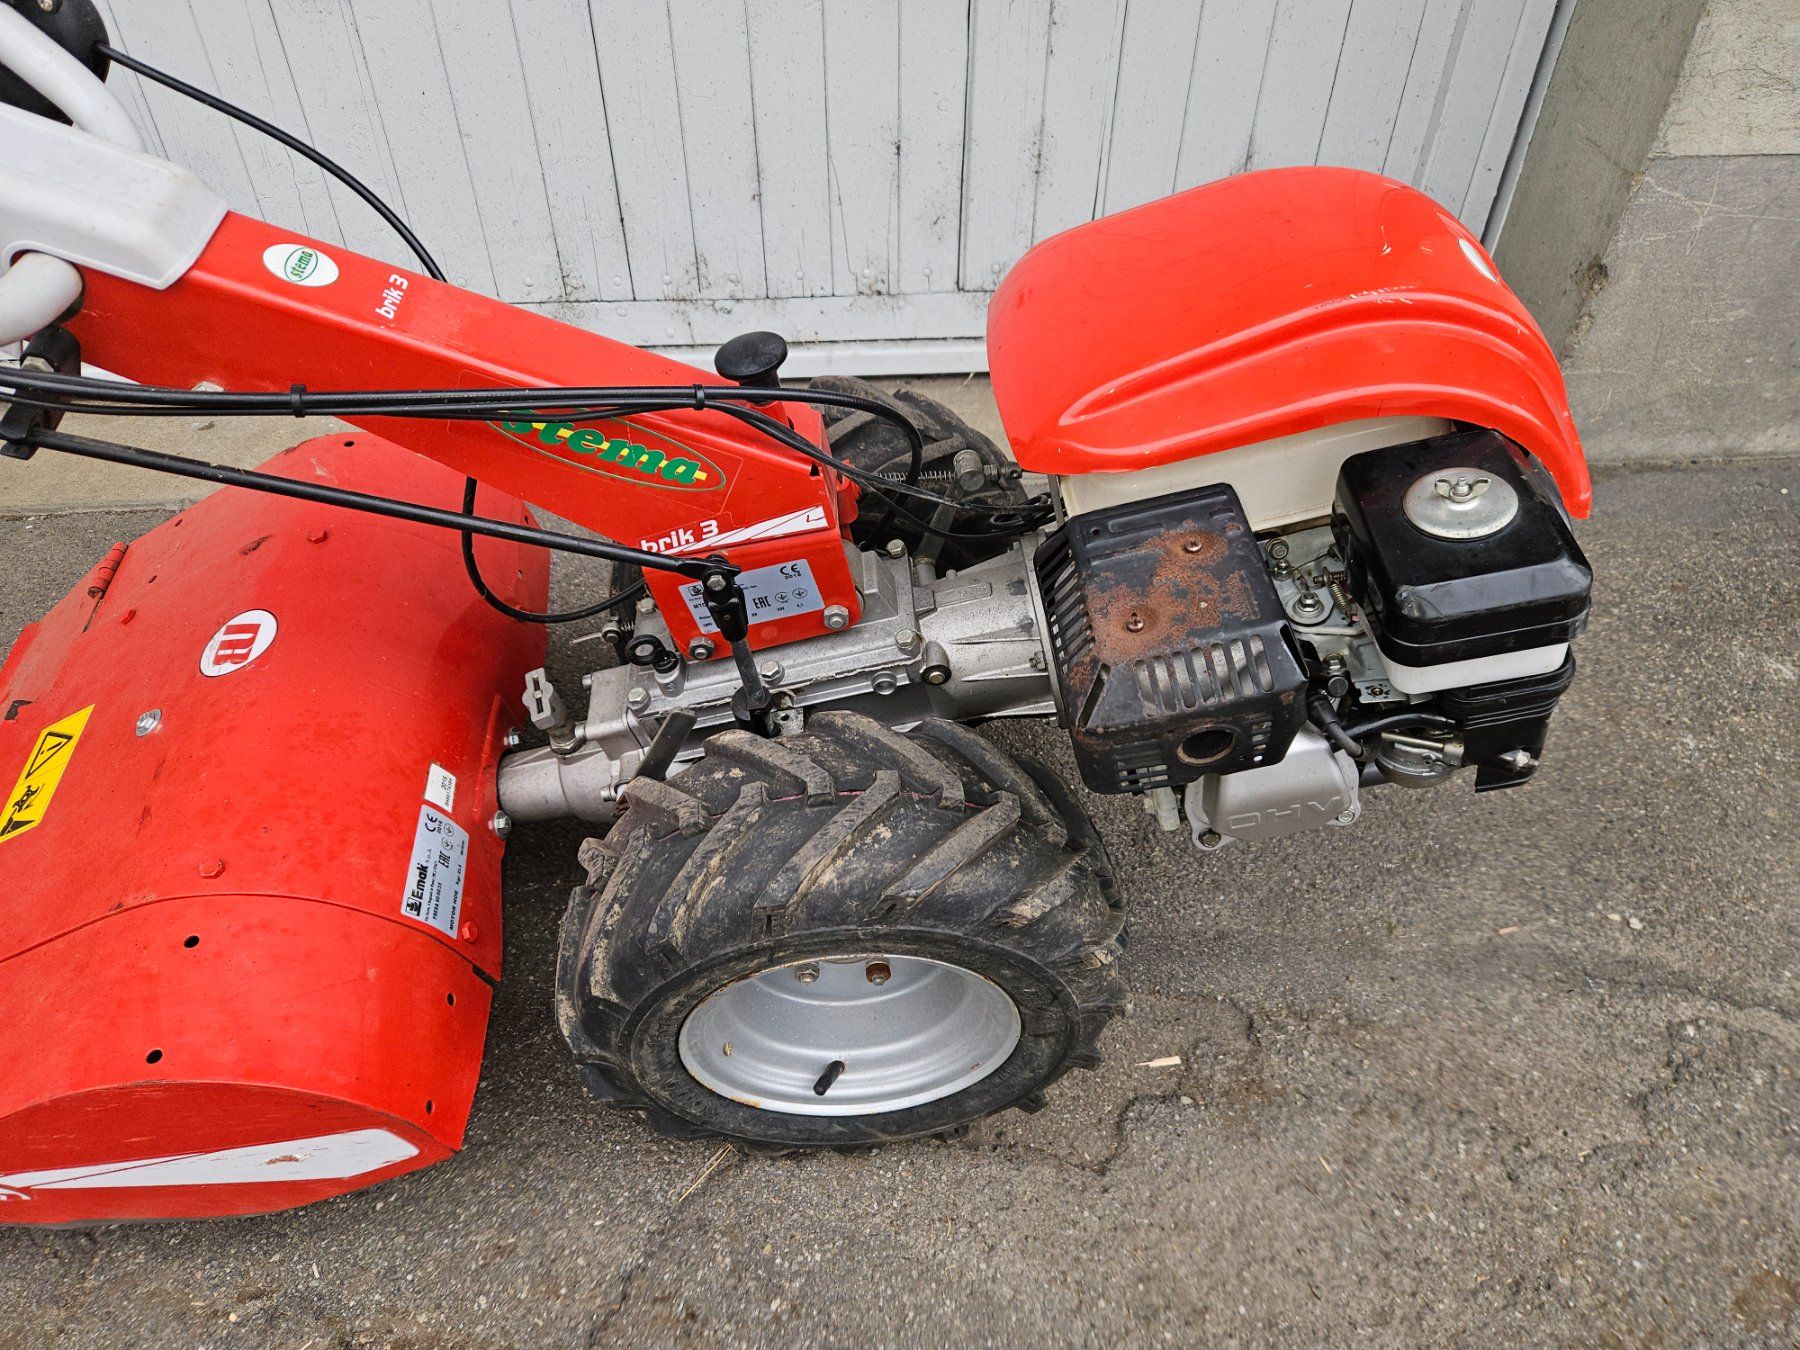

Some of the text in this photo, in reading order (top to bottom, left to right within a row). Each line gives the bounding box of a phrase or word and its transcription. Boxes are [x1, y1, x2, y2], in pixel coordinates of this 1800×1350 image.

[290, 250, 314, 279] stema
[375, 273, 409, 320] brik 3
[640, 519, 719, 554] brik 3
[412, 862, 429, 900] Emak
